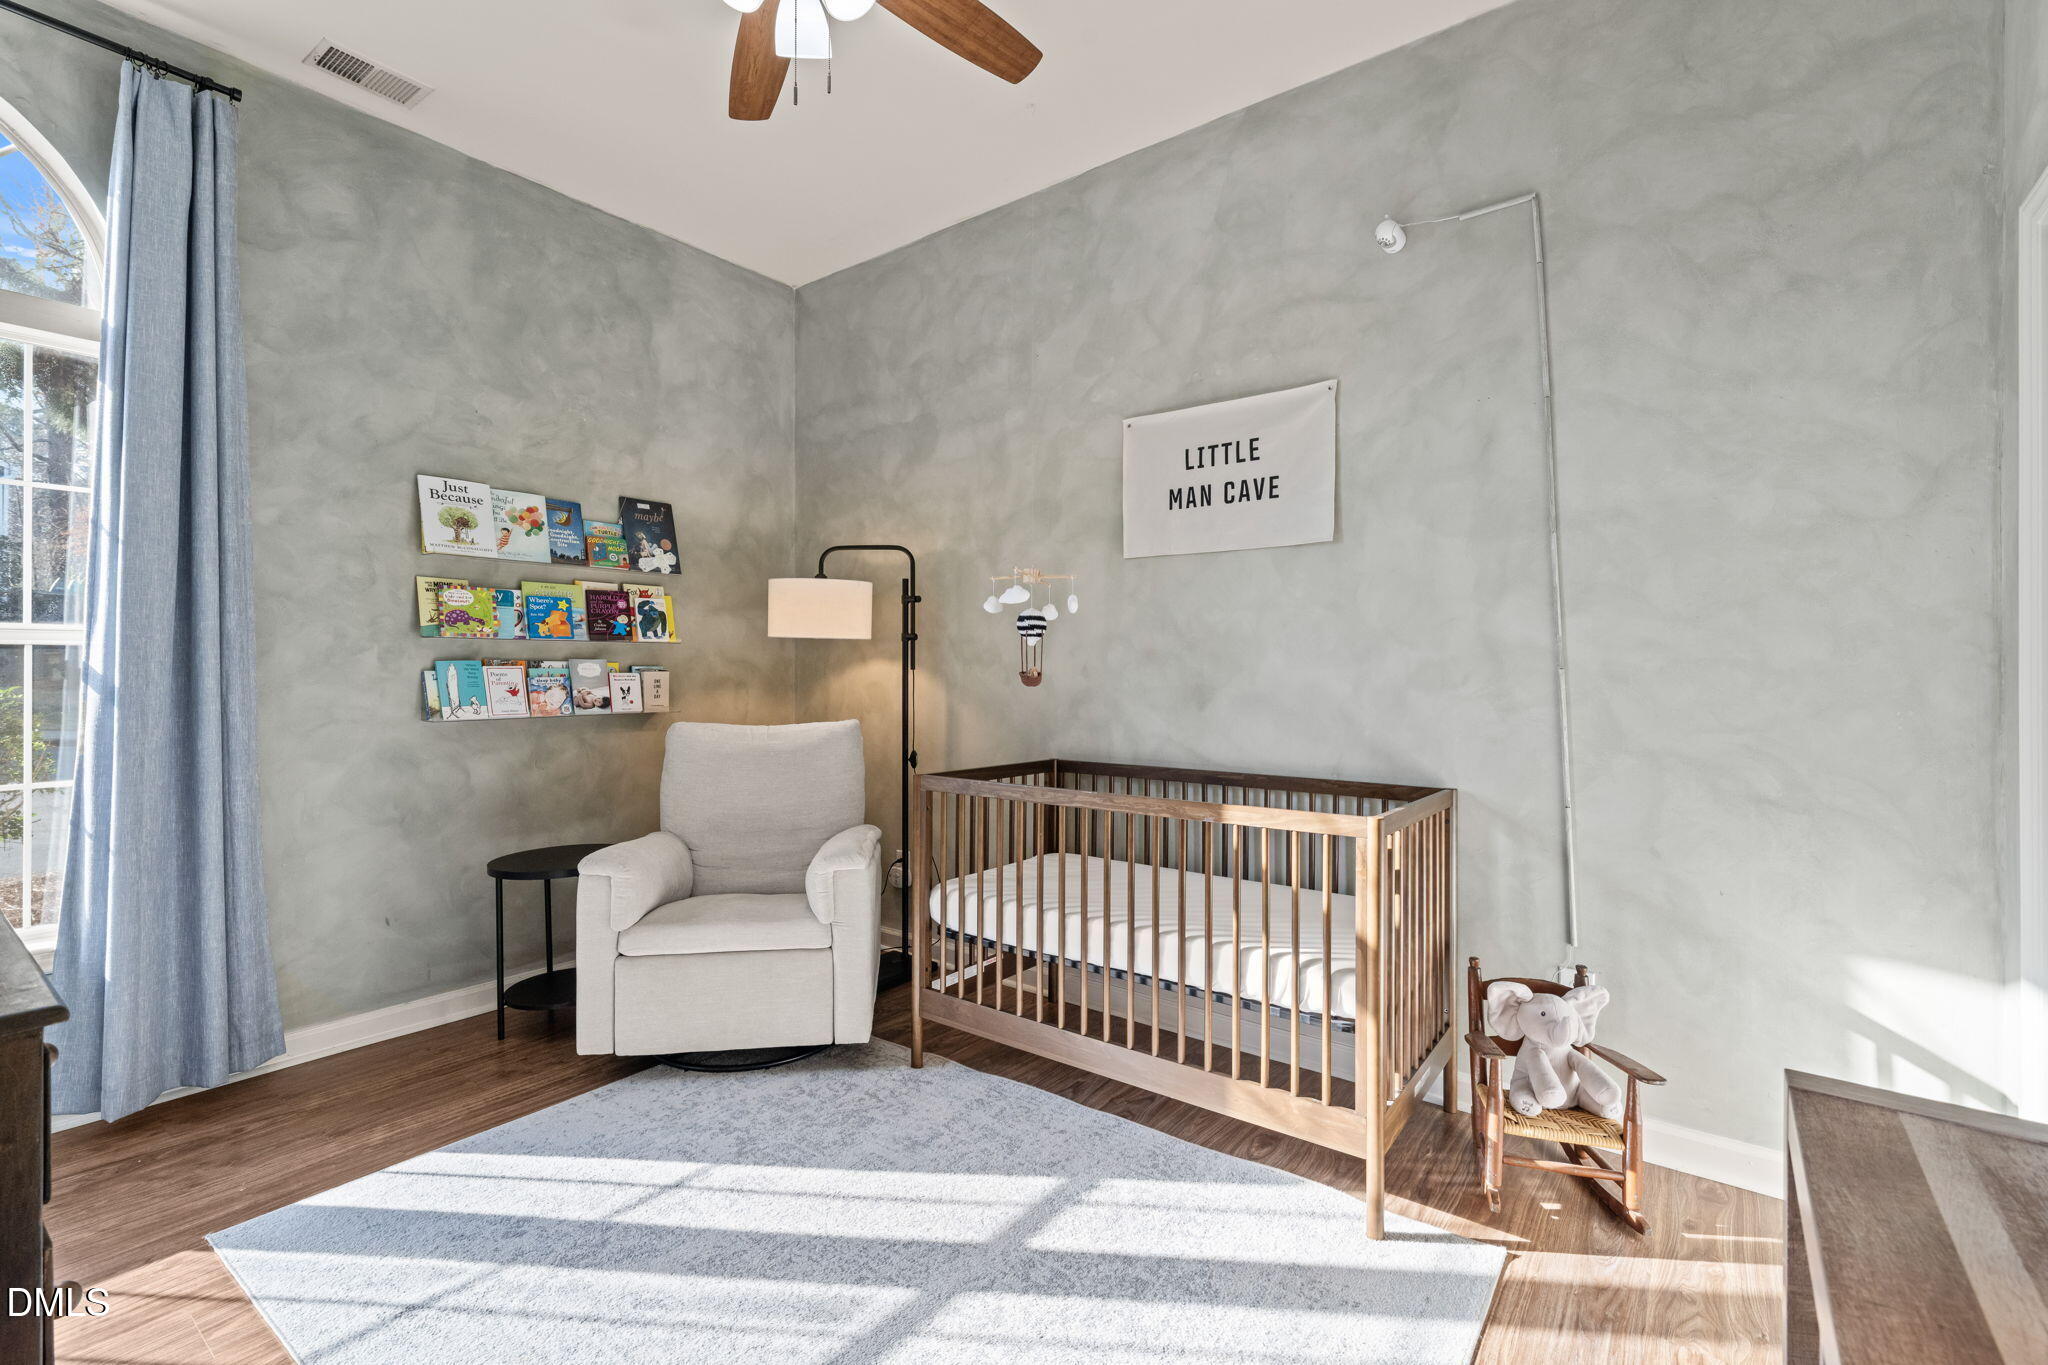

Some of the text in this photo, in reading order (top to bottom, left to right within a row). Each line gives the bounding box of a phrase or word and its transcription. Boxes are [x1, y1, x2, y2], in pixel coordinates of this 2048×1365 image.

[1185, 437, 1260, 470] LITTLE
[442, 480, 469, 493] Just
[429, 488, 484, 505] Because
[1169, 475, 1280, 510] MAN CAVE
[490, 496, 514, 505] nderful
[634, 512, 664, 523] maybe
[627, 588, 638, 596] Fox
[528, 596, 554, 604] Where's
[590, 602, 617, 610] PURPLE
